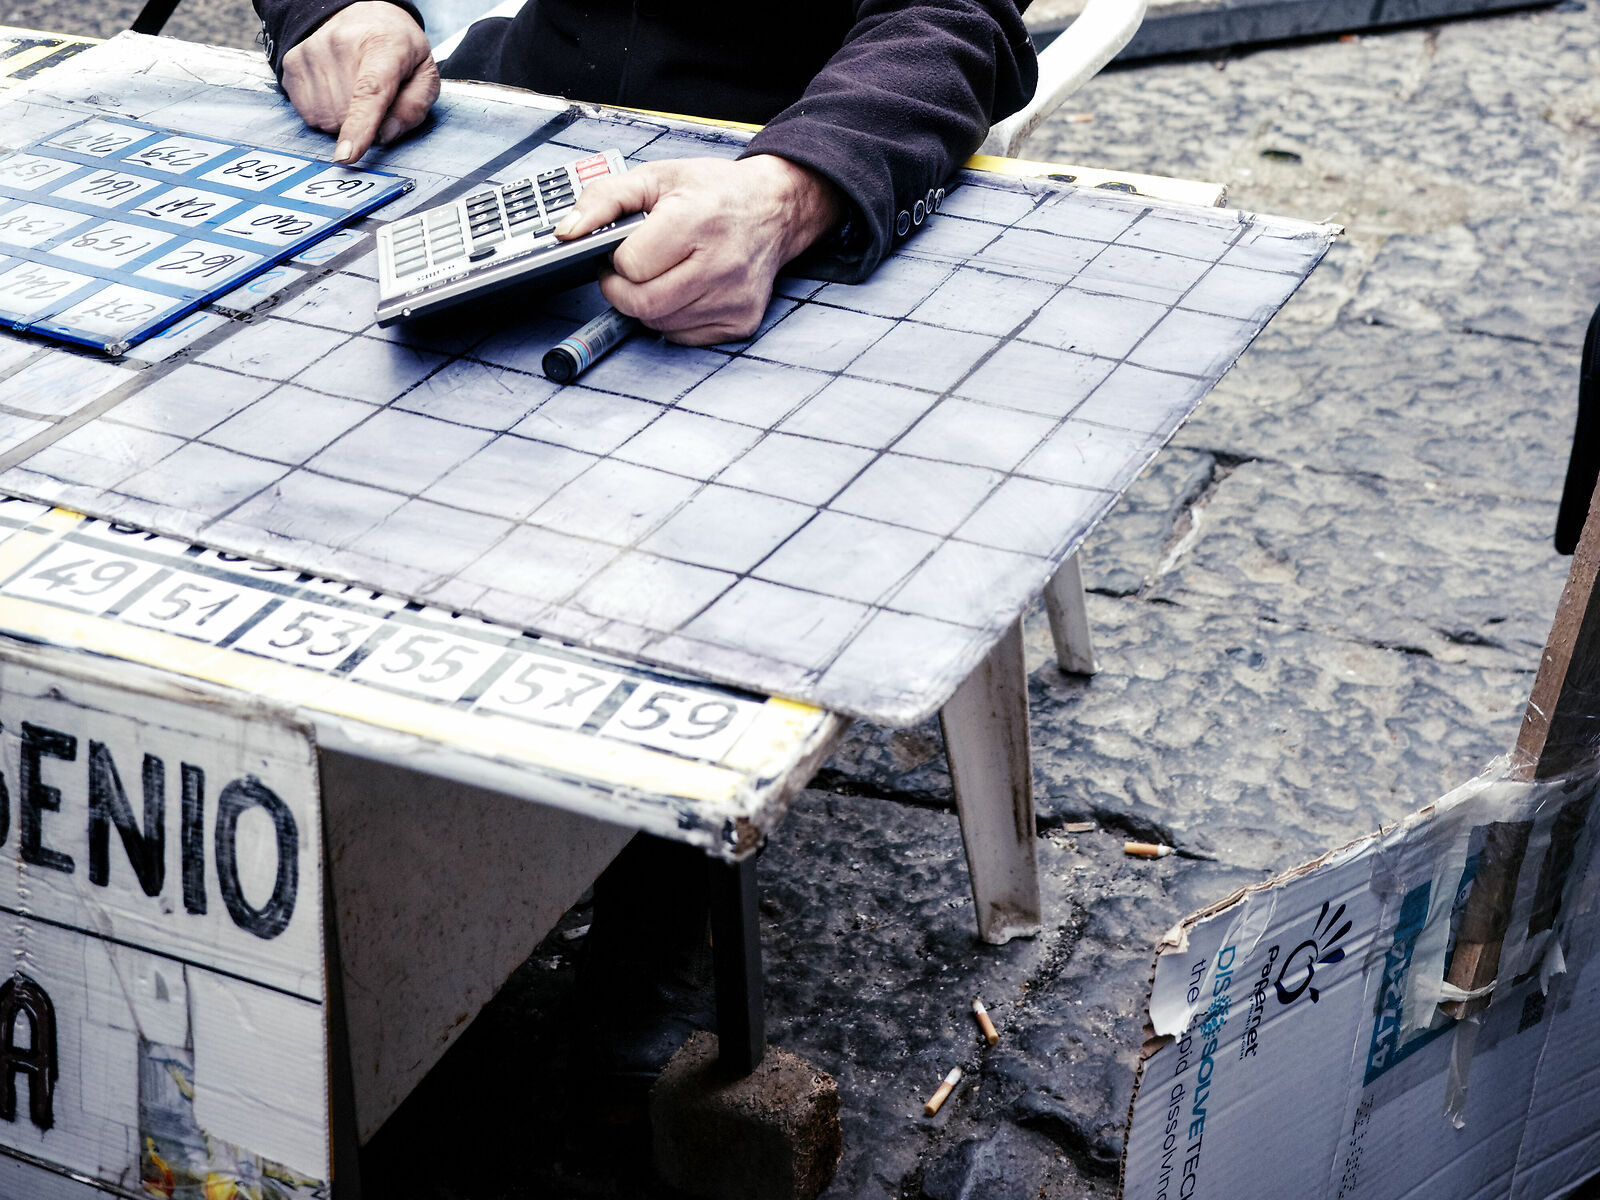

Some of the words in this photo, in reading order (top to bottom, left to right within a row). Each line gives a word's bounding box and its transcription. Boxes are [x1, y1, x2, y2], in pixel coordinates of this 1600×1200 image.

[140, 146, 209, 167] 239
[222, 159, 296, 182] 158
[305, 179, 376, 199] 163
[250, 213, 313, 236] 240
[72, 228, 152, 257] 159
[156, 250, 246, 278] 162
[30, 558, 138, 596] 49
[149, 581, 241, 626] 51
[268, 610, 370, 656] 53
[380, 633, 480, 684] 55
[499, 661, 606, 710] 57
[620, 690, 739, 740] 59
[0, 720, 300, 940] ENIO
[1186, 958, 1207, 1004] the
[1244, 944, 1281, 1057] Papernet
[1173, 1014, 1199, 1079] pid
